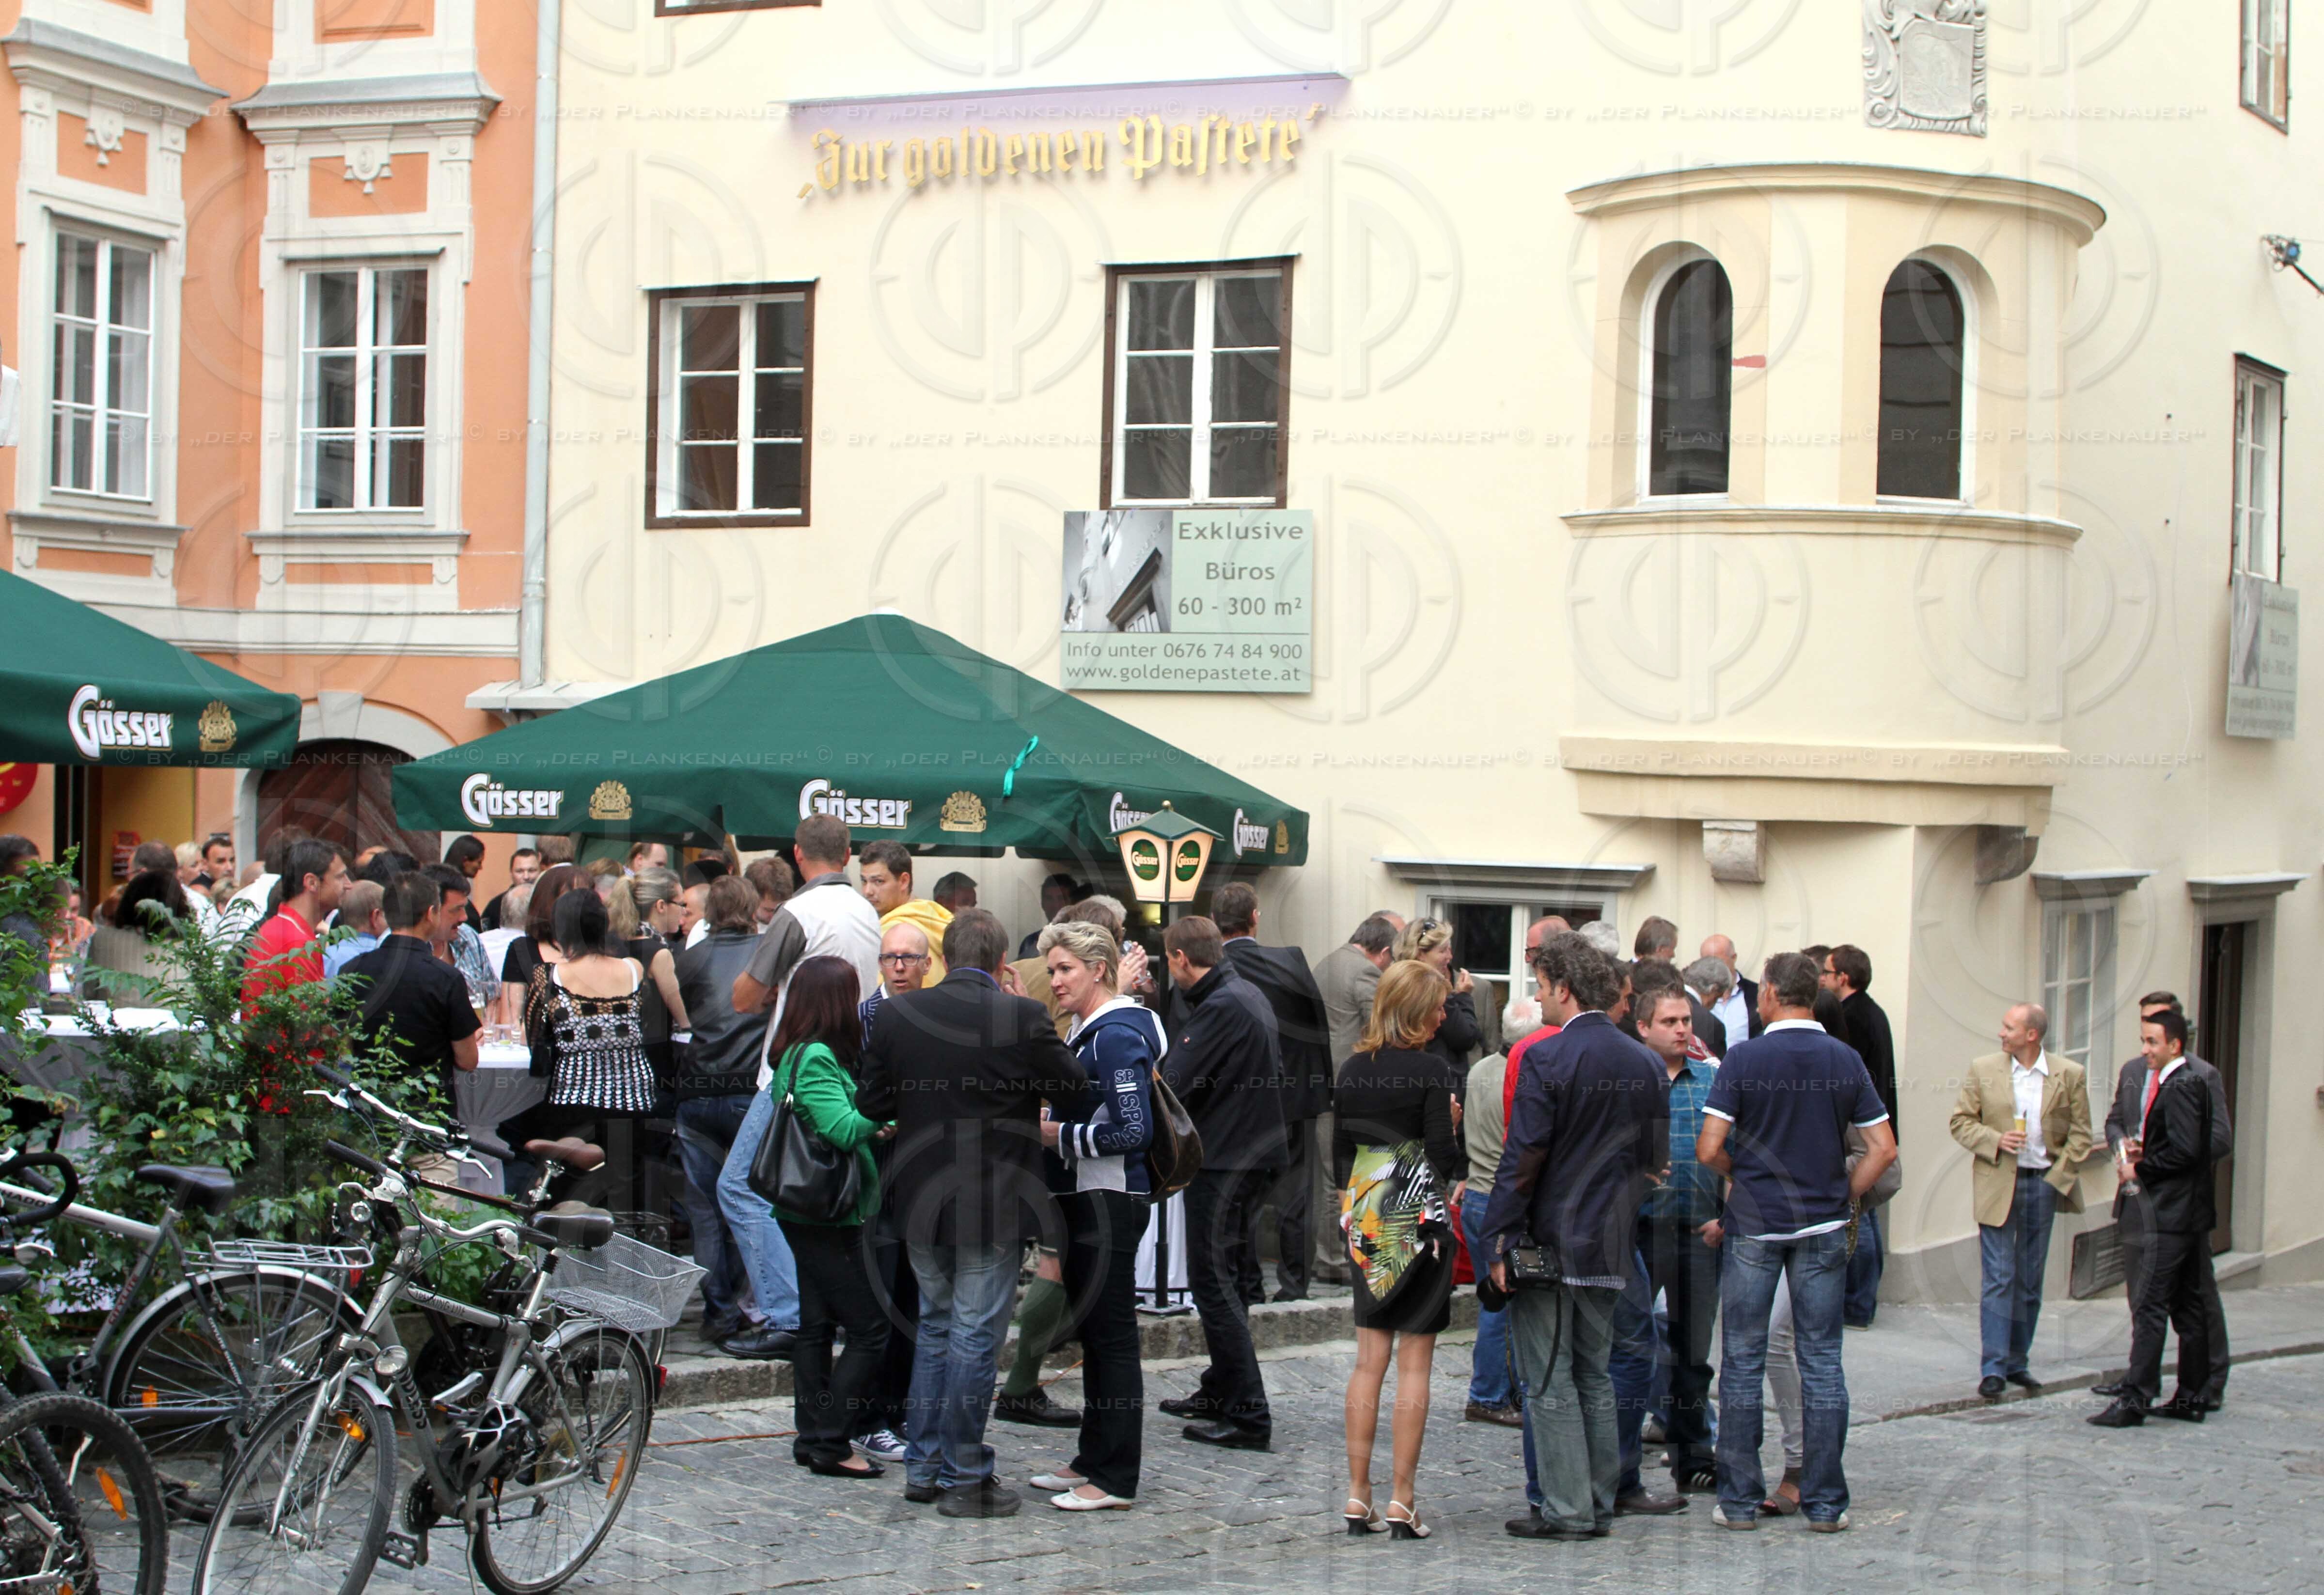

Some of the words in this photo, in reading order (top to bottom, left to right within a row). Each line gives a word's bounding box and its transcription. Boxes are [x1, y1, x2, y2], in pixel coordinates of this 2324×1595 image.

[904, 125, 1105, 187] goldenen
[1178, 522, 1303, 541] Exklusive
[1206, 562, 1275, 580] Büros
[1178, 597, 1203, 615] 60
[1228, 597, 1266, 615] 300
[1067, 642, 1101, 658] Info
[1108, 645, 1157, 658] unter
[1163, 643, 1206, 658] 0676
[1214, 644, 1235, 658] 74
[1241, 644, 1263, 658] 84
[1270, 644, 1303, 659] 900
[1067, 664, 1302, 682] www.goldenepastete.at
[68, 684, 173, 761] Gösser
[461, 773, 564, 828] Gösser
[799, 779, 912, 829] Gösser
[1233, 808, 1269, 859] Gösser
[1132, 851, 1158, 867] Gösser
[1177, 853, 1199, 868] Gösser
